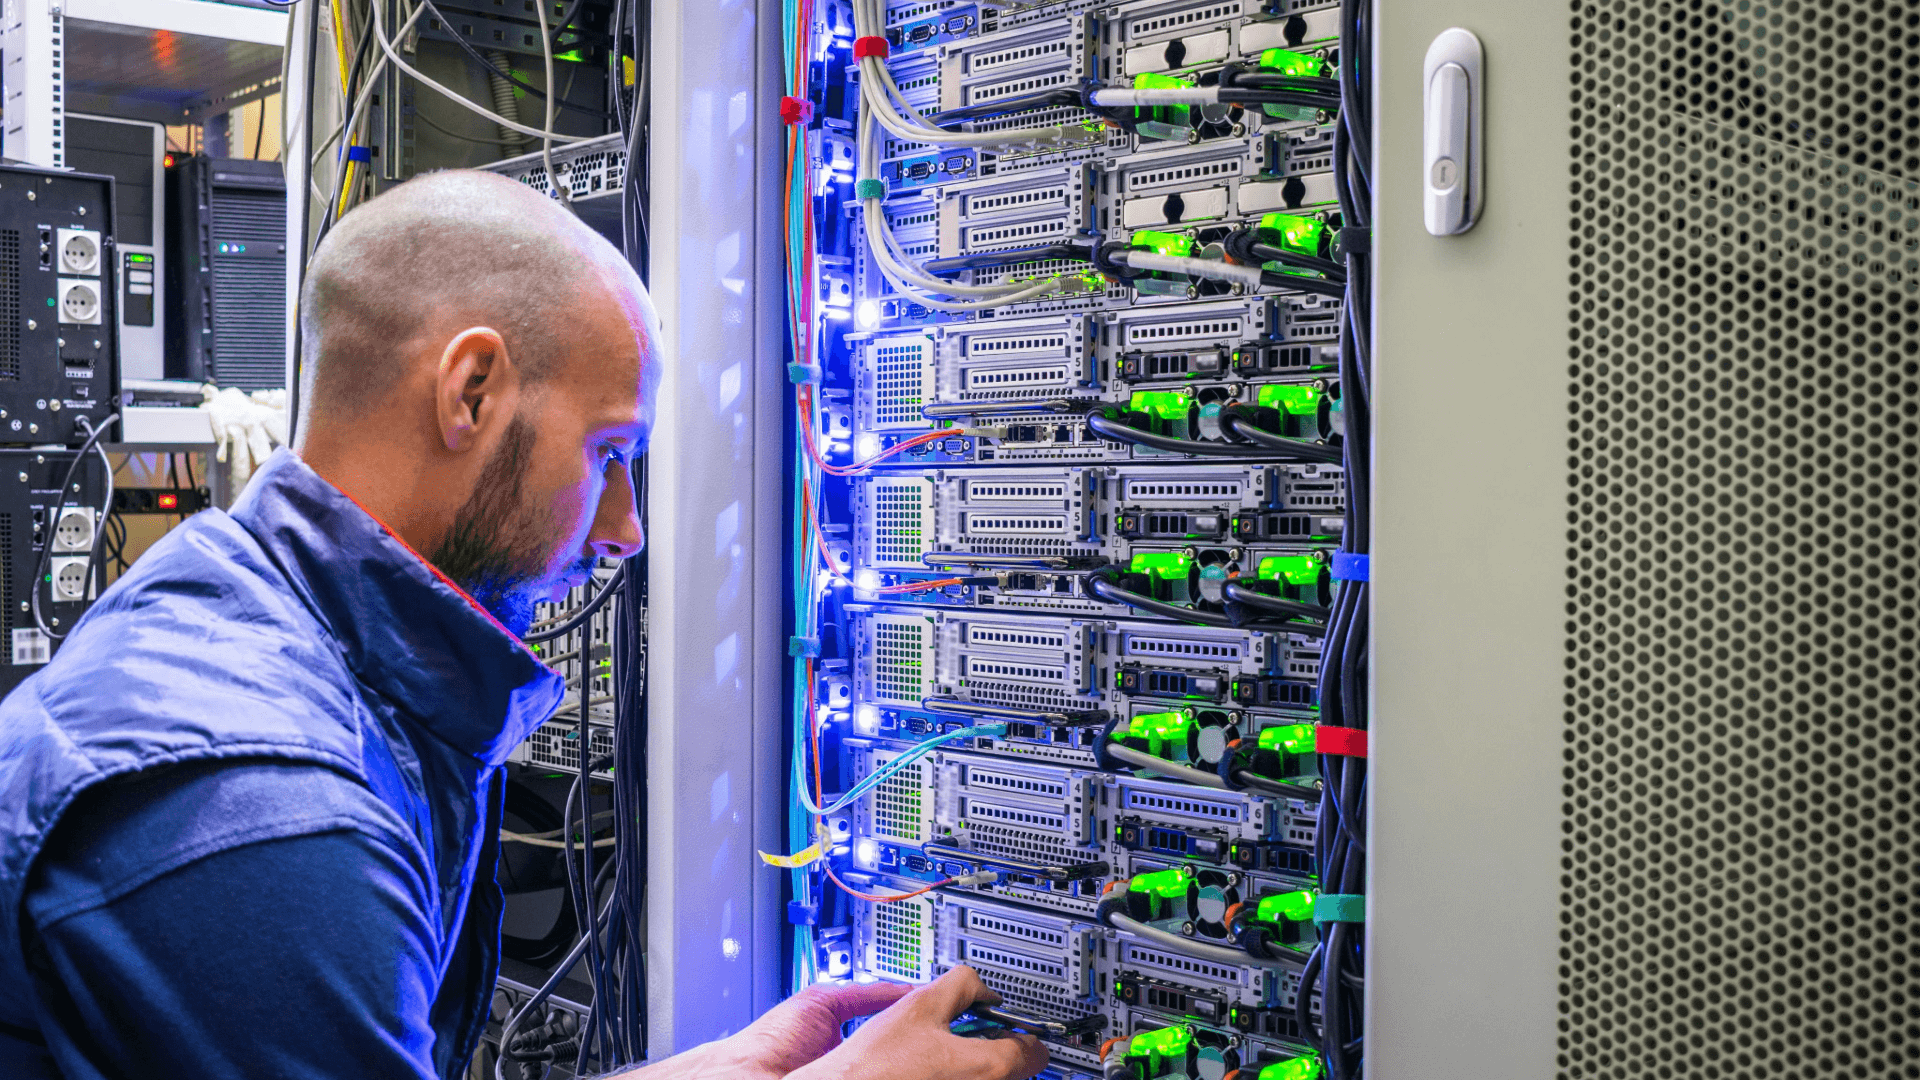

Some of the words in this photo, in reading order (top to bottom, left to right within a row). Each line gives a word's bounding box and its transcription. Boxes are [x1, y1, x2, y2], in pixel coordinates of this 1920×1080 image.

[1076, 19, 1082, 29] 4
[1076, 54, 1082, 64] 5
[1256, 142, 1262, 152] 6
[1074, 170, 1080, 179] 4
[1074, 205, 1080, 215] 5
[1256, 307, 1263, 317] 6
[1075, 322, 1081, 332] 4
[1075, 357, 1081, 367] 5
[1074, 477, 1080, 487] 4
[1256, 475, 1262, 485] 6
[1074, 512, 1080, 522] 5
[1114, 550, 1118, 559] 1
[1074, 631, 1080, 641] 4
[1256, 642, 1262, 652] 6
[1074, 666, 1080, 675] 5
[1114, 704, 1119, 713] 1
[1074, 784, 1080, 793] 4
[1255, 809, 1261, 819] 6
[1074, 818, 1080, 828] 5
[1113, 856, 1118, 865] 1
[1073, 937, 1079, 947] 4
[1073, 972, 1079, 981] 5
[1254, 976, 1260, 986] 6
[1112, 1010, 1117, 1019] 1
